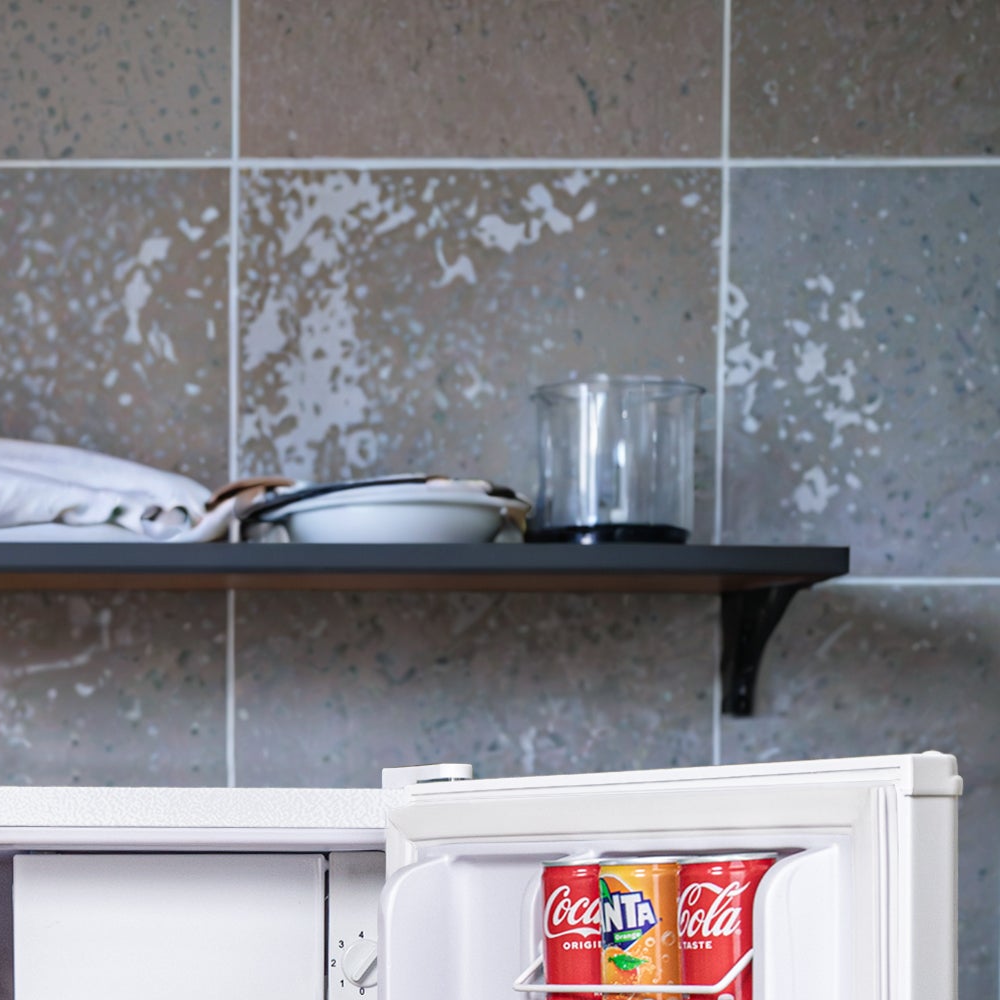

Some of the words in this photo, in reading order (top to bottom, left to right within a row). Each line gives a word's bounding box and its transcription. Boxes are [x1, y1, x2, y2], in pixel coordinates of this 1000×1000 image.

[544, 885, 601, 938] Coca
[603, 893, 656, 932] NTA
[677, 881, 751, 937] Cola
[614, 931, 641, 941] Orange
[338, 940, 344, 948] 3
[683, 940, 713, 950] TASTE
[331, 959, 336, 967] 2
